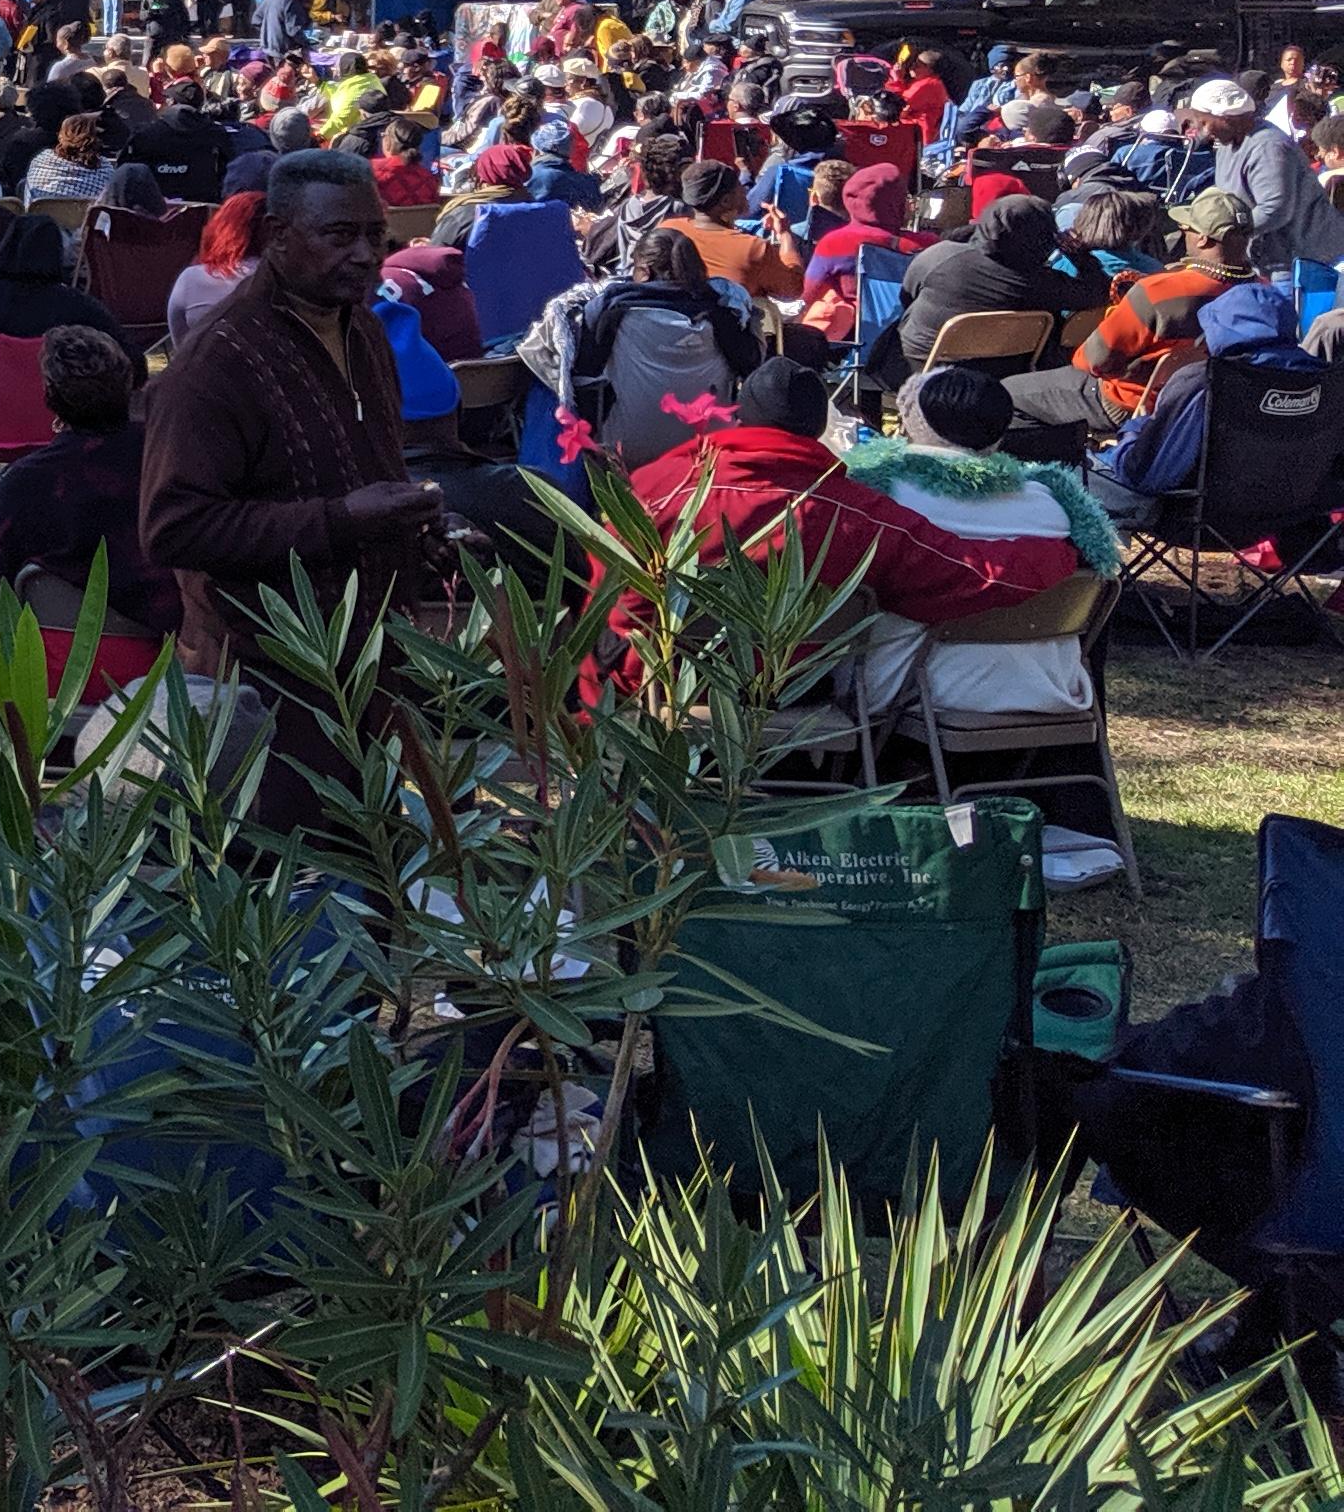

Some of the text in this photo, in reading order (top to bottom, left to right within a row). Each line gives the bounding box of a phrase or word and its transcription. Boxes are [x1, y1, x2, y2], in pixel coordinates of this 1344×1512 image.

[1268, 393, 1312, 409] Coleman
[783, 849, 911, 869] Aiken Electric
[903, 868, 938, 885] Inc.
